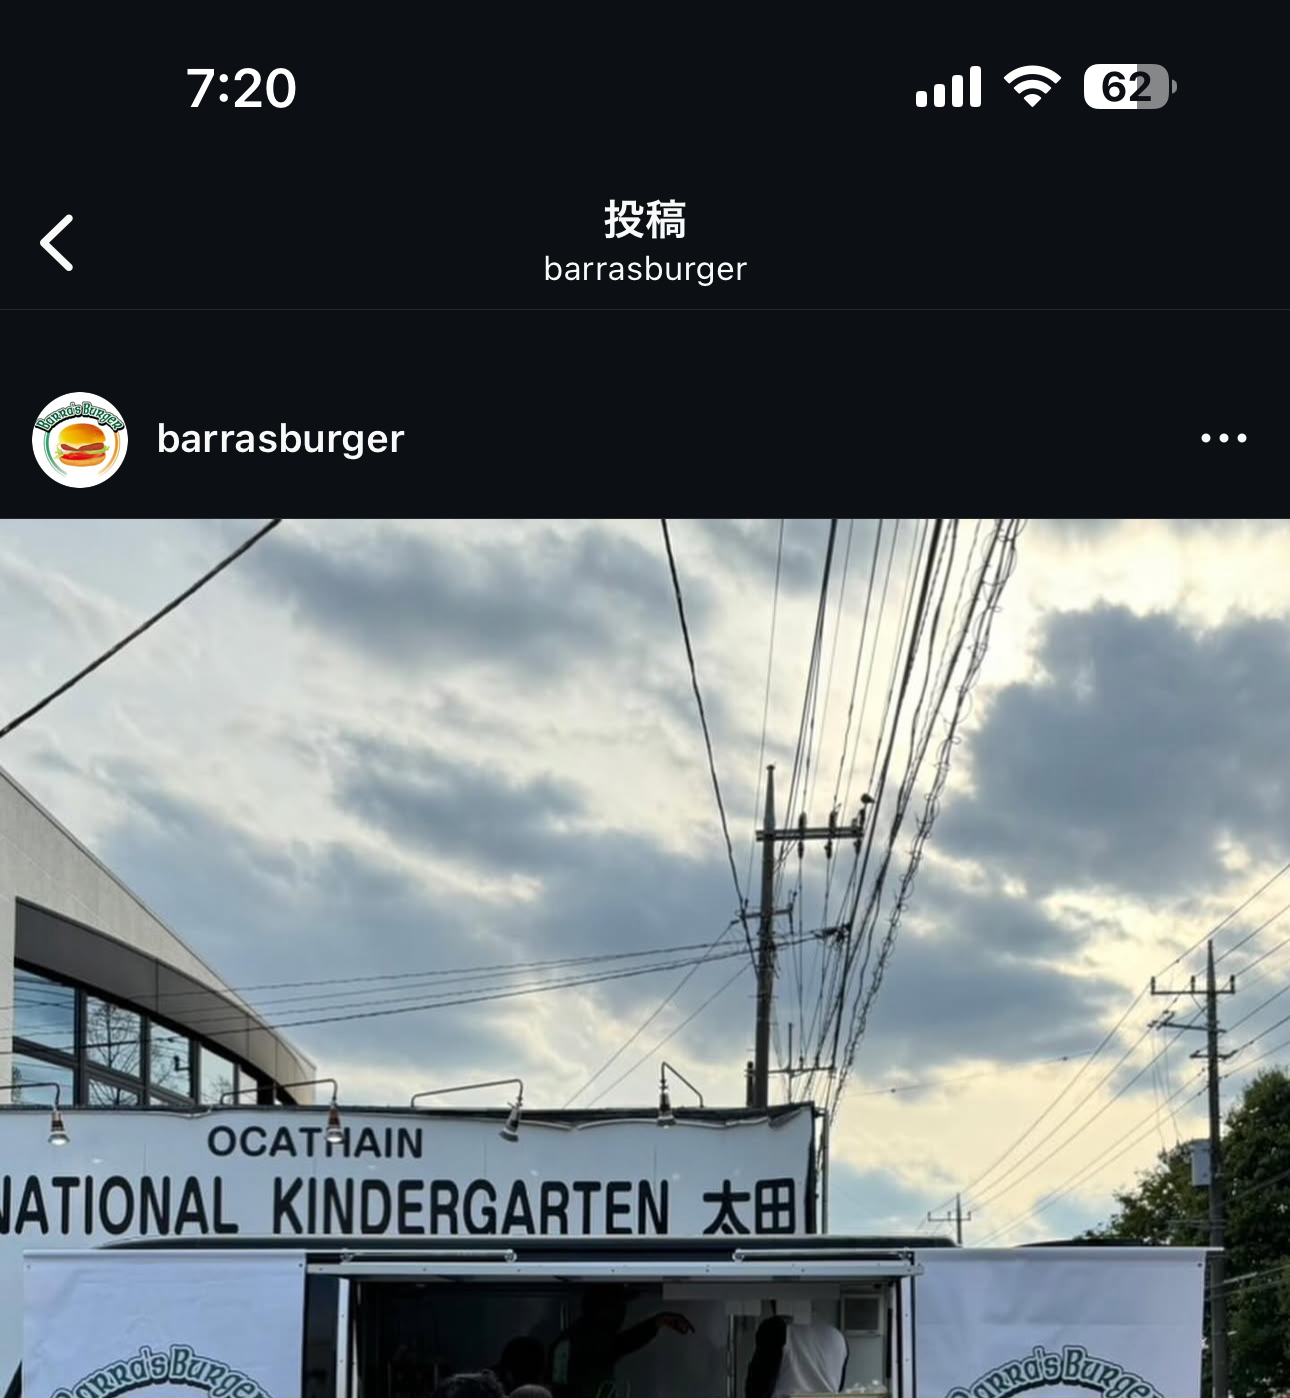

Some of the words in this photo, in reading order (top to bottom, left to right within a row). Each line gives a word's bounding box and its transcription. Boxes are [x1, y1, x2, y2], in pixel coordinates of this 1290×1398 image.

[187, 68, 297, 108] 7:20
[1103, 72, 1151, 102] 62
[604, 199, 686, 239] 投稿
[546, 255, 747, 286] barrasburger
[81, 401, 125, 433] Burger
[159, 423, 404, 459] barrasburger
[208, 1125, 423, 1158] OCATHAIN
[273, 1178, 670, 1236] KINDERGARTEN
[703, 1178, 797, 1236] 太田
